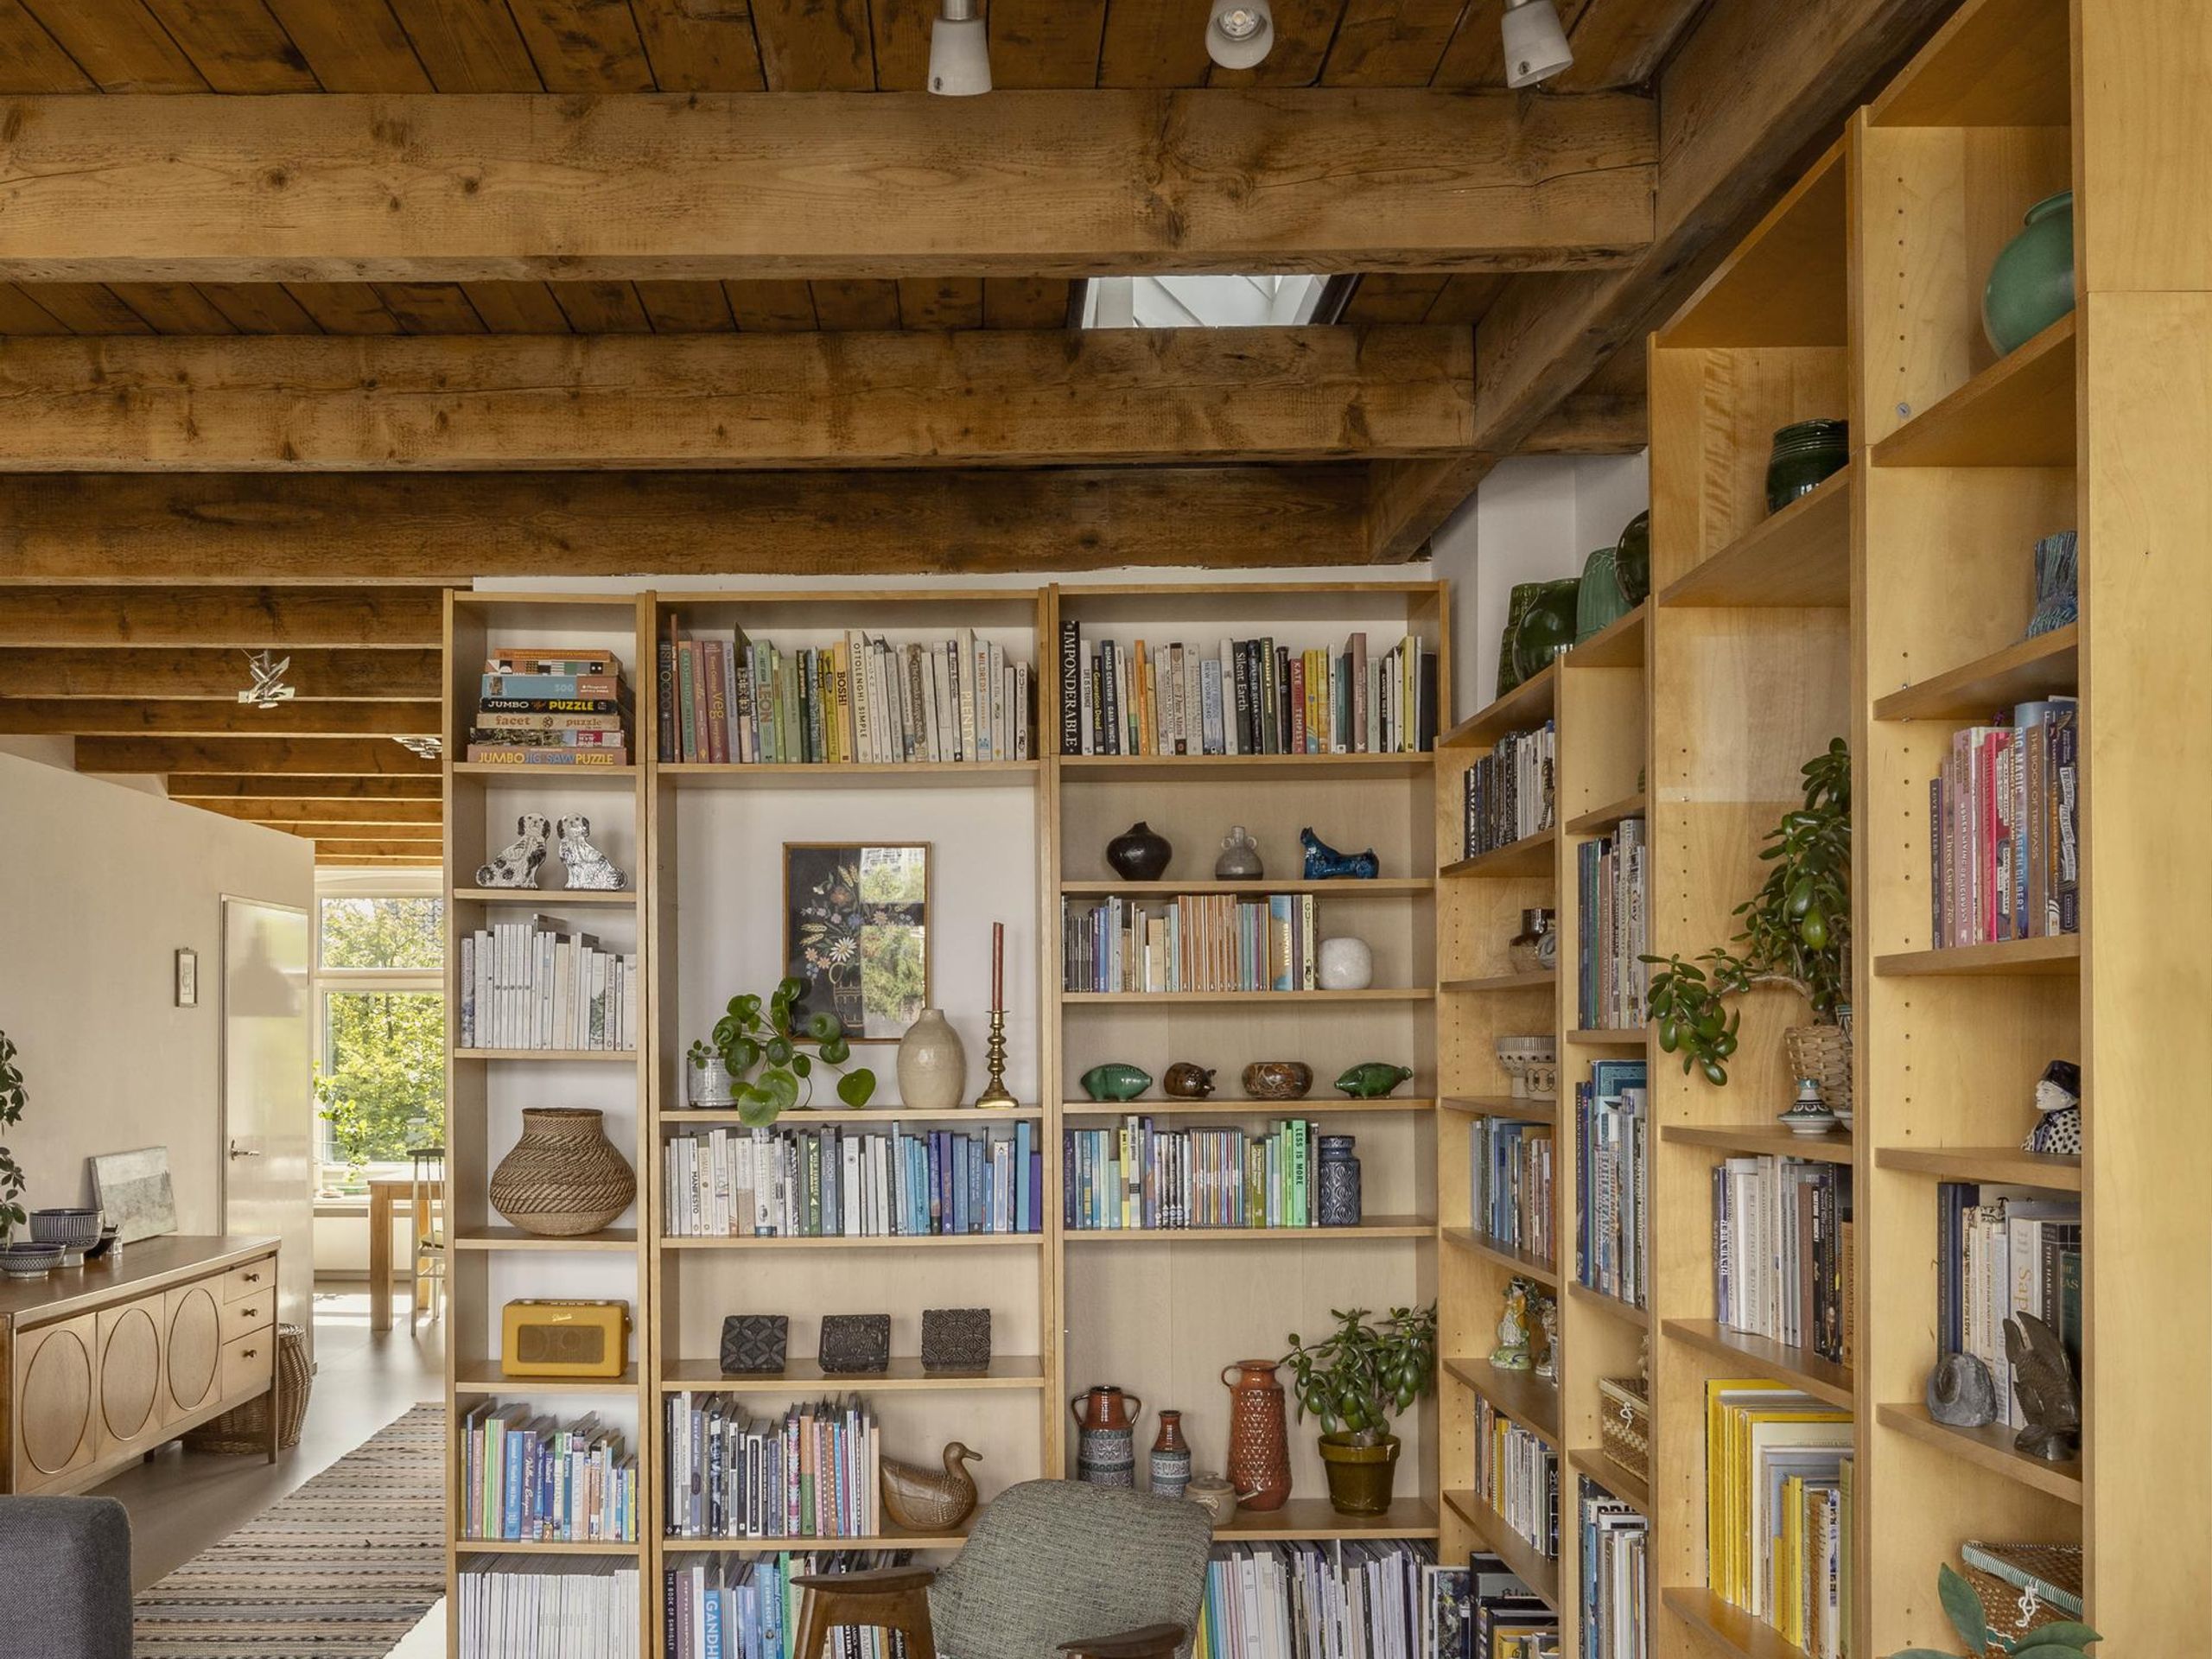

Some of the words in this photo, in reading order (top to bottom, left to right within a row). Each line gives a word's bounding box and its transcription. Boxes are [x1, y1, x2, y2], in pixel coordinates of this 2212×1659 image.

[853, 643, 863, 702] OTTOLENGHI
[978, 652, 987, 693] MILDREDS
[1236, 652, 1245, 682] Silent
[758, 683, 772, 723] LEON
[836, 672, 847, 706] BOSH!
[1064, 631, 1077, 747] IMPONDERABLE
[1238, 683, 1248, 711] Earth
[549, 699, 594, 710] PUZZLE
[709, 693, 725, 720] veg
[961, 691, 974, 742] PLENTY
[495, 715, 531, 725] facet
[566, 718, 602, 727] puzzle
[478, 753, 524, 764] JUMBO
[525, 753, 540, 764] JIG
[547, 753, 575, 764] SAW
[575, 753, 613, 765] PUZZLE
[2031, 791, 2038, 805] OF
